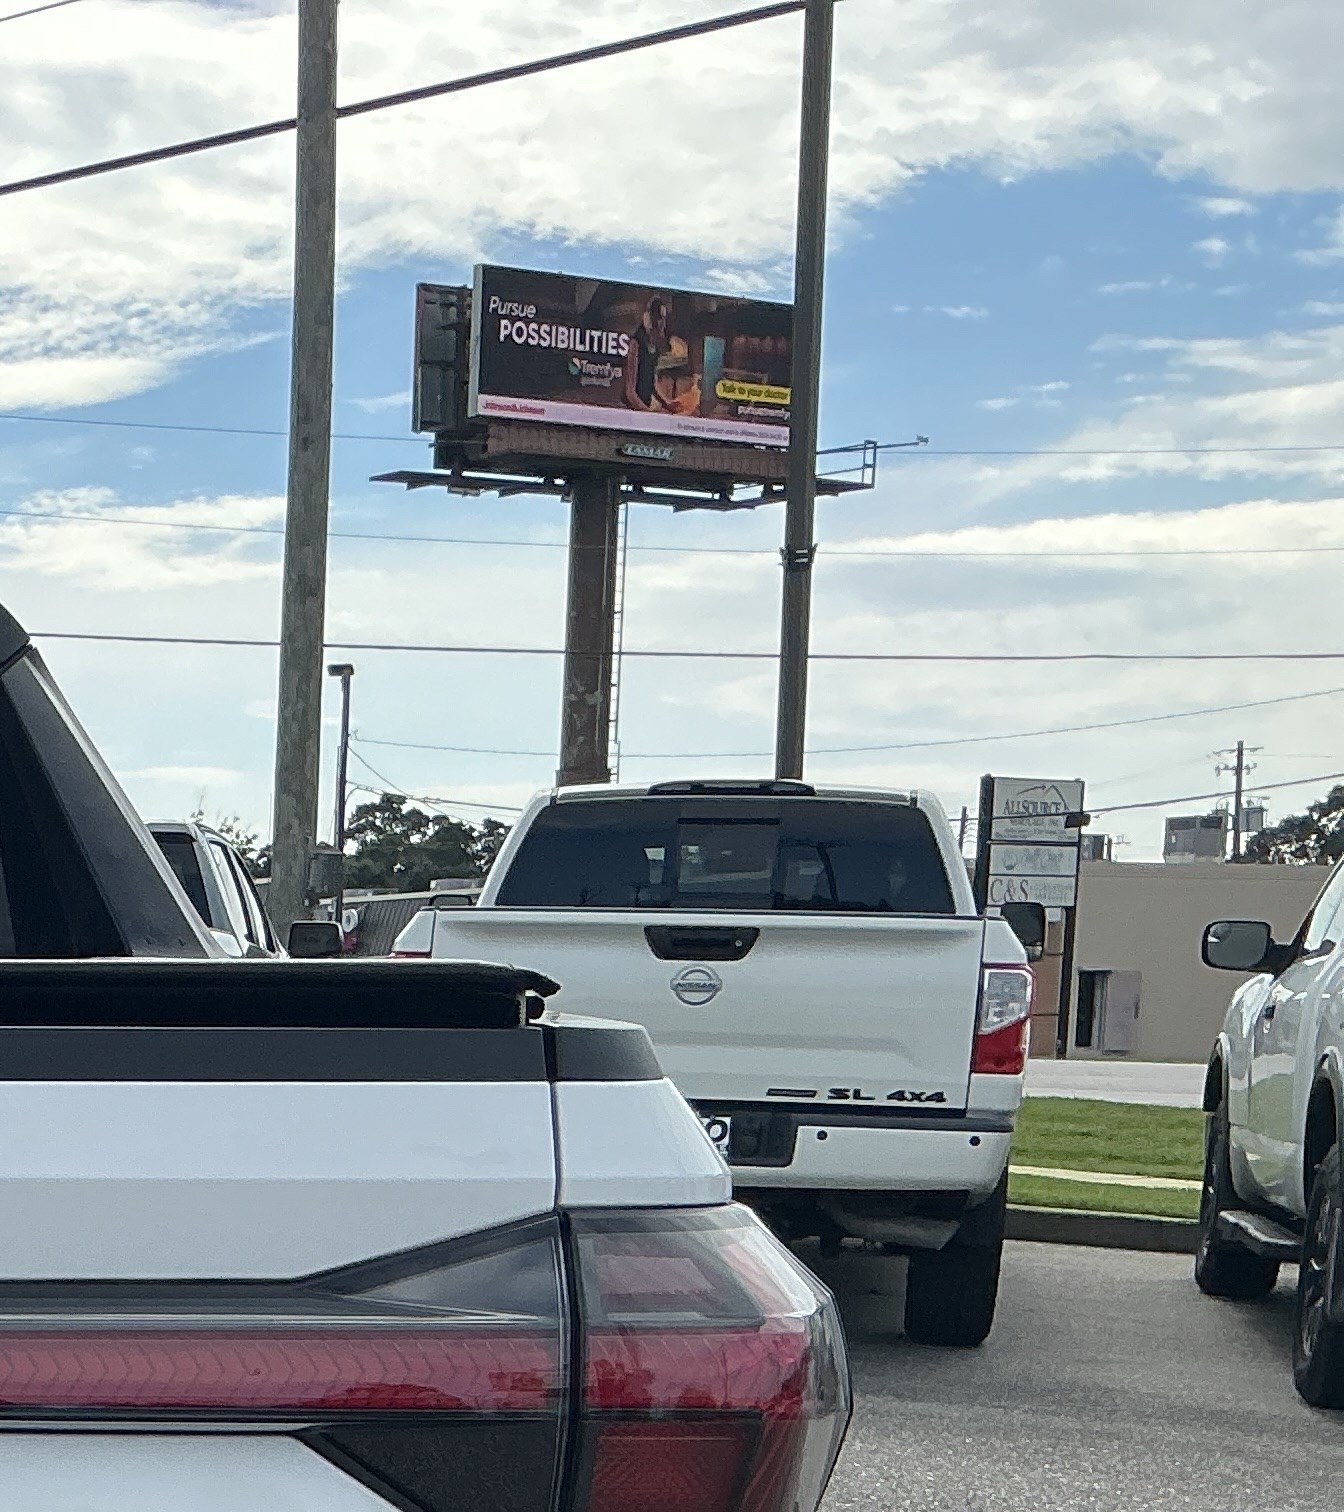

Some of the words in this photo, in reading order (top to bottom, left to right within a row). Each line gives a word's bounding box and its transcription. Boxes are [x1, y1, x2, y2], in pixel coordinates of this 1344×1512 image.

[489, 295, 537, 318] Pursue
[499, 319, 631, 357] POSSIBILITIES
[827, 1088, 875, 1100] SL
